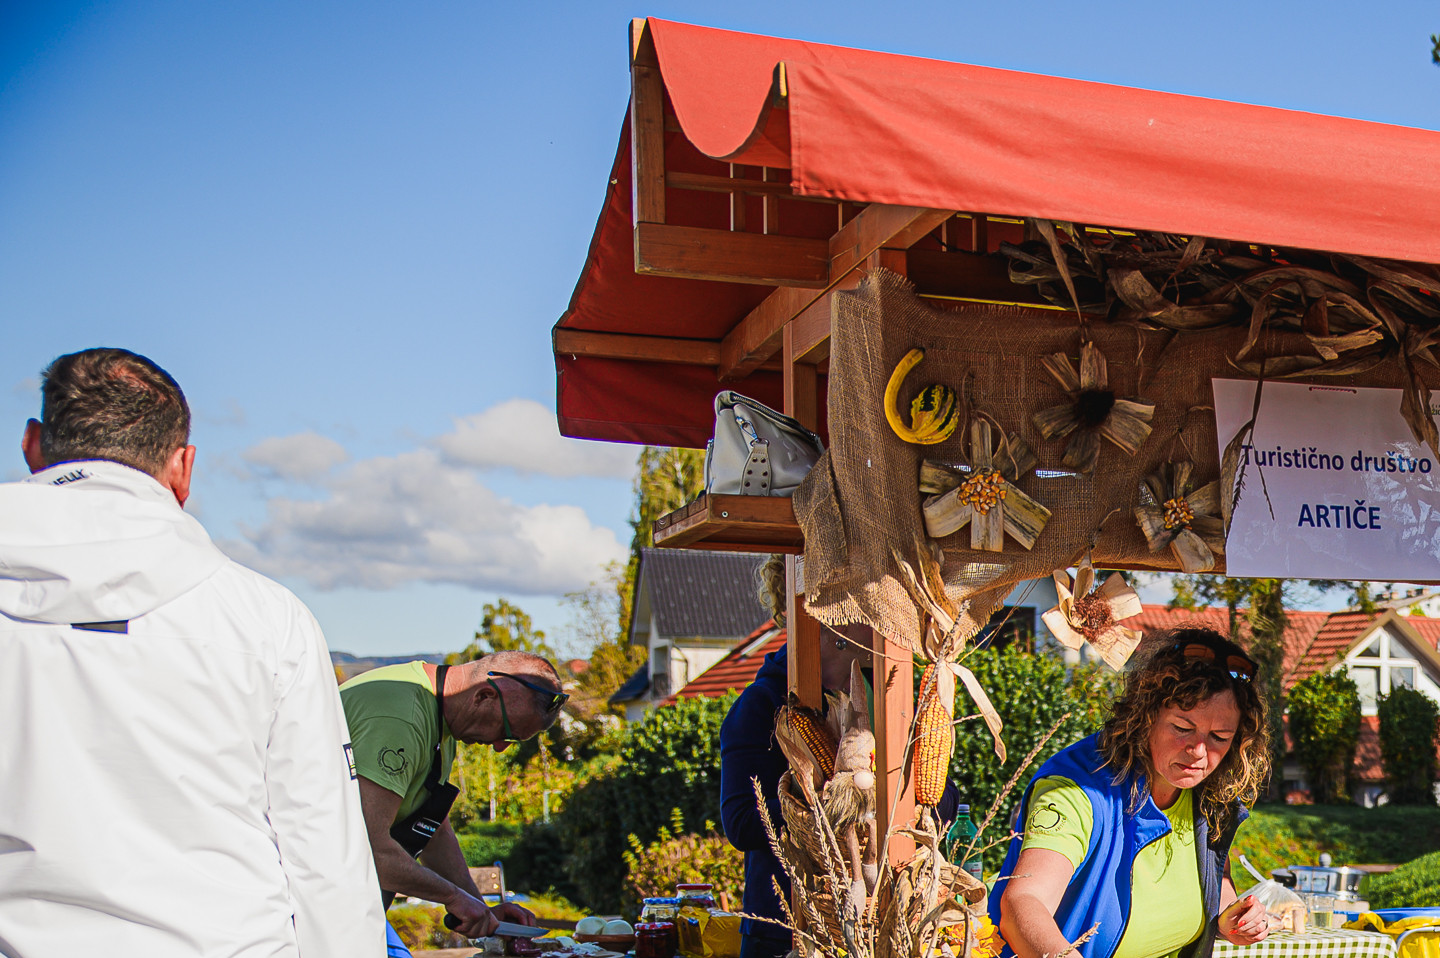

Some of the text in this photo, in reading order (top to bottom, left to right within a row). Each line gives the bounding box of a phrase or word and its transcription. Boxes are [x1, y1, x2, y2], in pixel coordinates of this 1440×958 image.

[1241, 444, 1432, 473] Turistično društvo
[1298, 500, 1381, 529] ARTIČE
